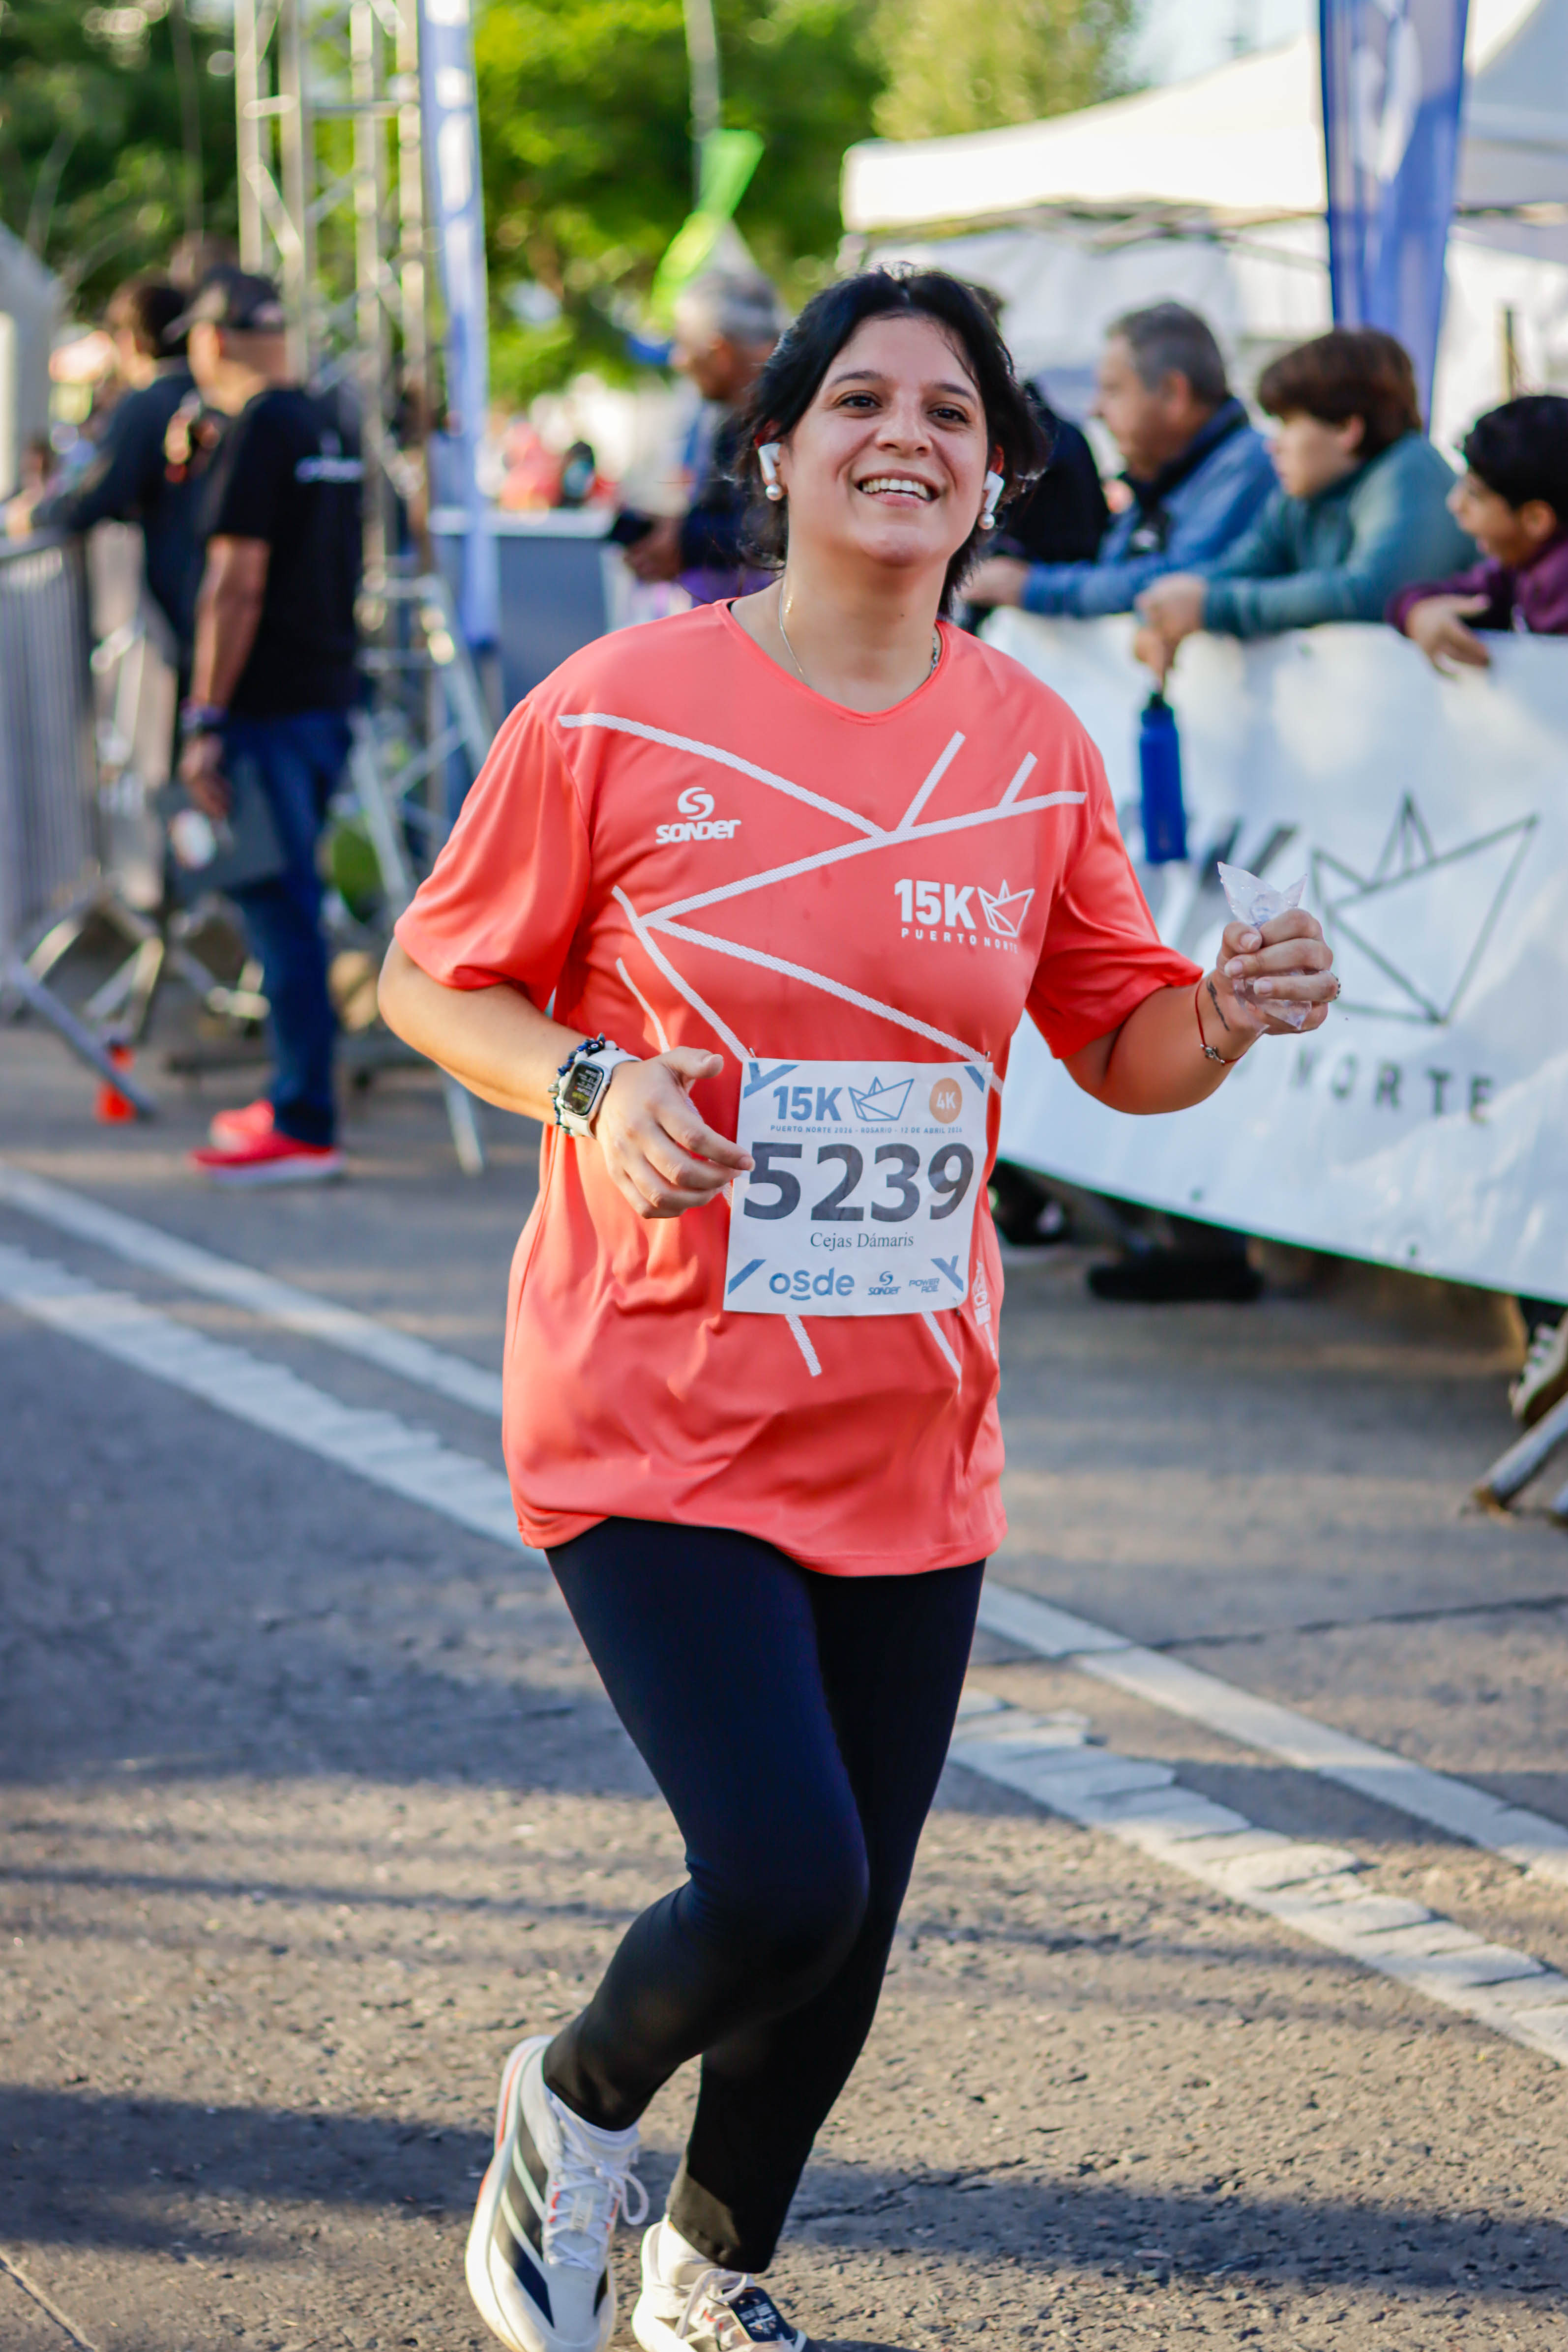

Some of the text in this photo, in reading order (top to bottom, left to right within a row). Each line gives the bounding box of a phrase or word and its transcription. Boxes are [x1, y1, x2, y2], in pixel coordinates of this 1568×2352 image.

[894, 879, 976, 929] 15K
[901, 928, 1018, 954] PUERTO NORTE
[936, 1092, 956, 1109] 4K
[1293, 1050, 1496, 1124] NORTE
[773, 1086, 843, 1121] 15K
[743, 1141, 974, 1223] 5239
[810, 1232, 914, 1251] Cejas Dámaris
[769, 1267, 855, 1296] osde
[909, 1277, 940, 1287] POWER
